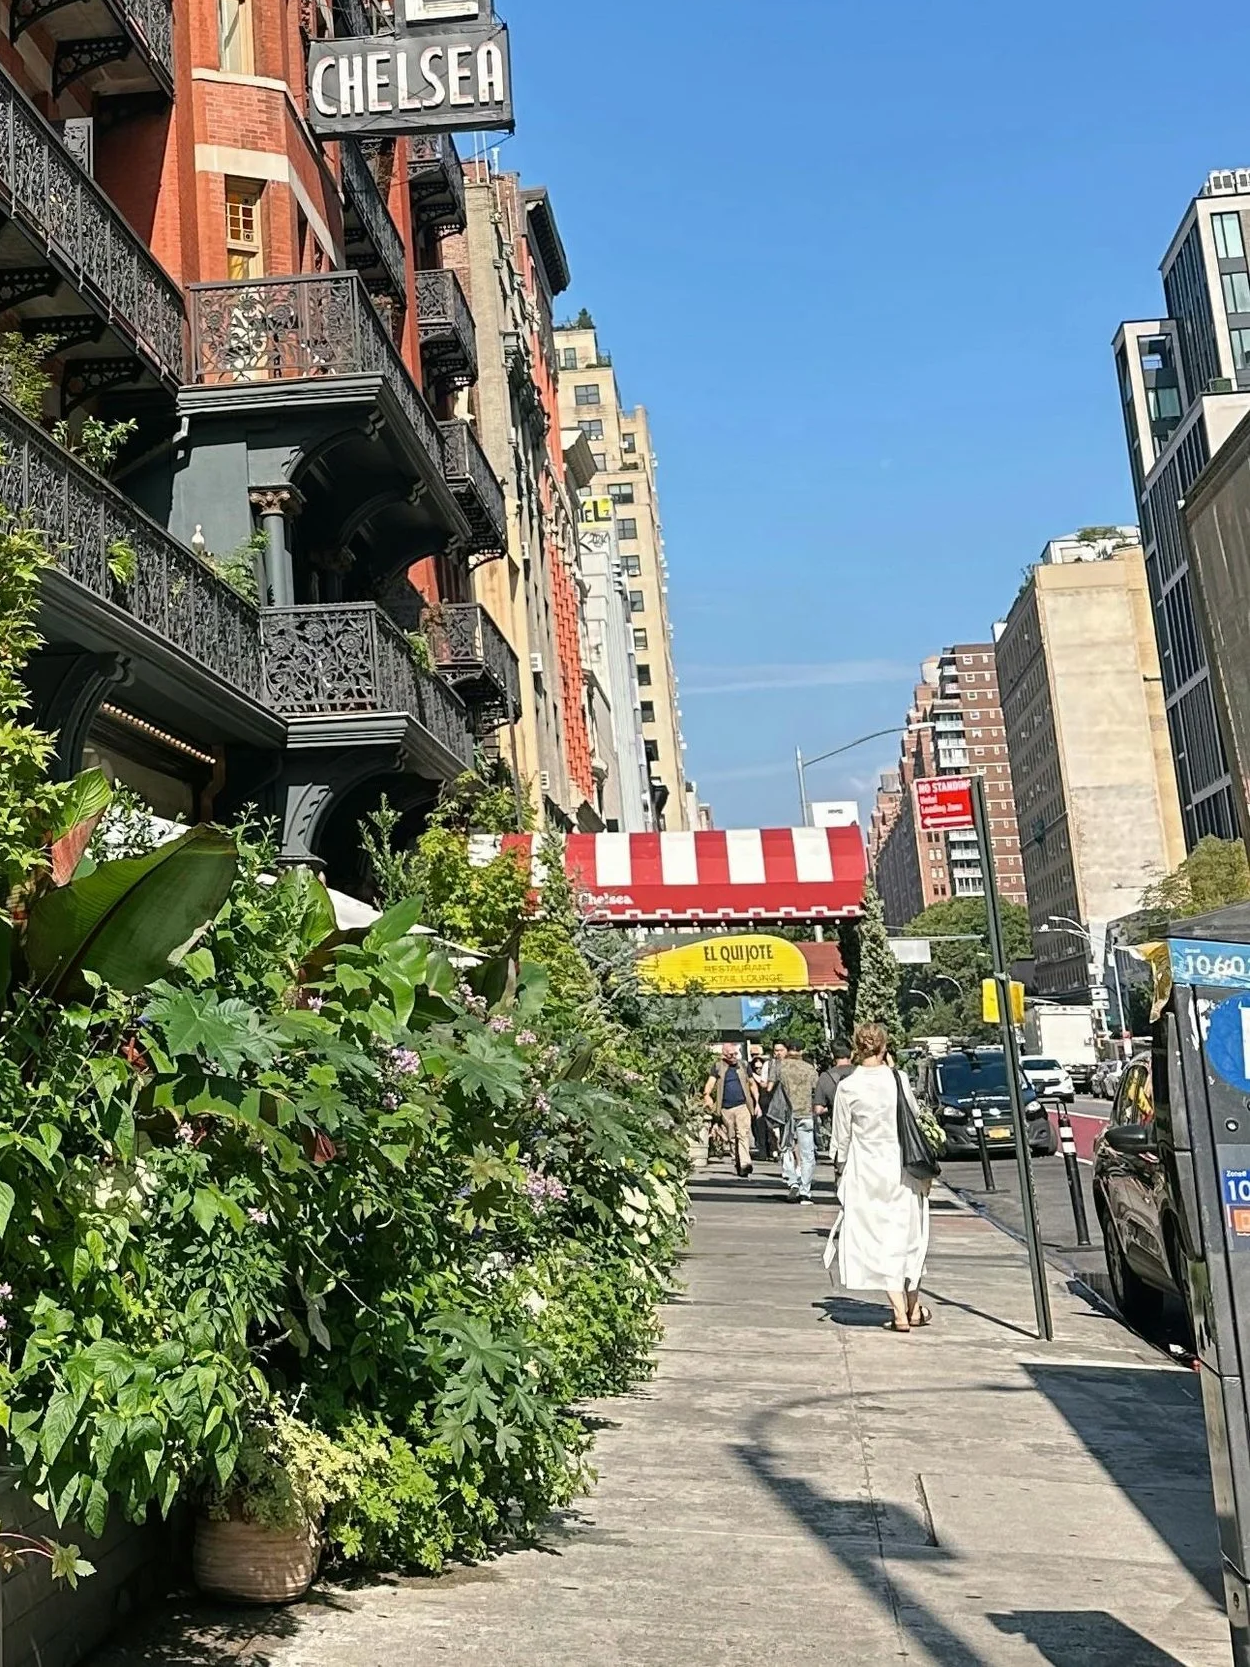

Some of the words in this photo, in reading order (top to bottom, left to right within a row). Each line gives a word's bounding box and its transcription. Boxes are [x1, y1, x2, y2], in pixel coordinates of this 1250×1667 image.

[311, 41, 504, 118] CHELSEA
[918, 784, 931, 794] NO
[703, 945, 718, 961] EL
[720, 944, 774, 963] QUIJOTE
[704, 964, 771, 973] RESTAURANT
[1186, 954, 1250, 976] 1060
[741, 973, 783, 983] LOUNGE
